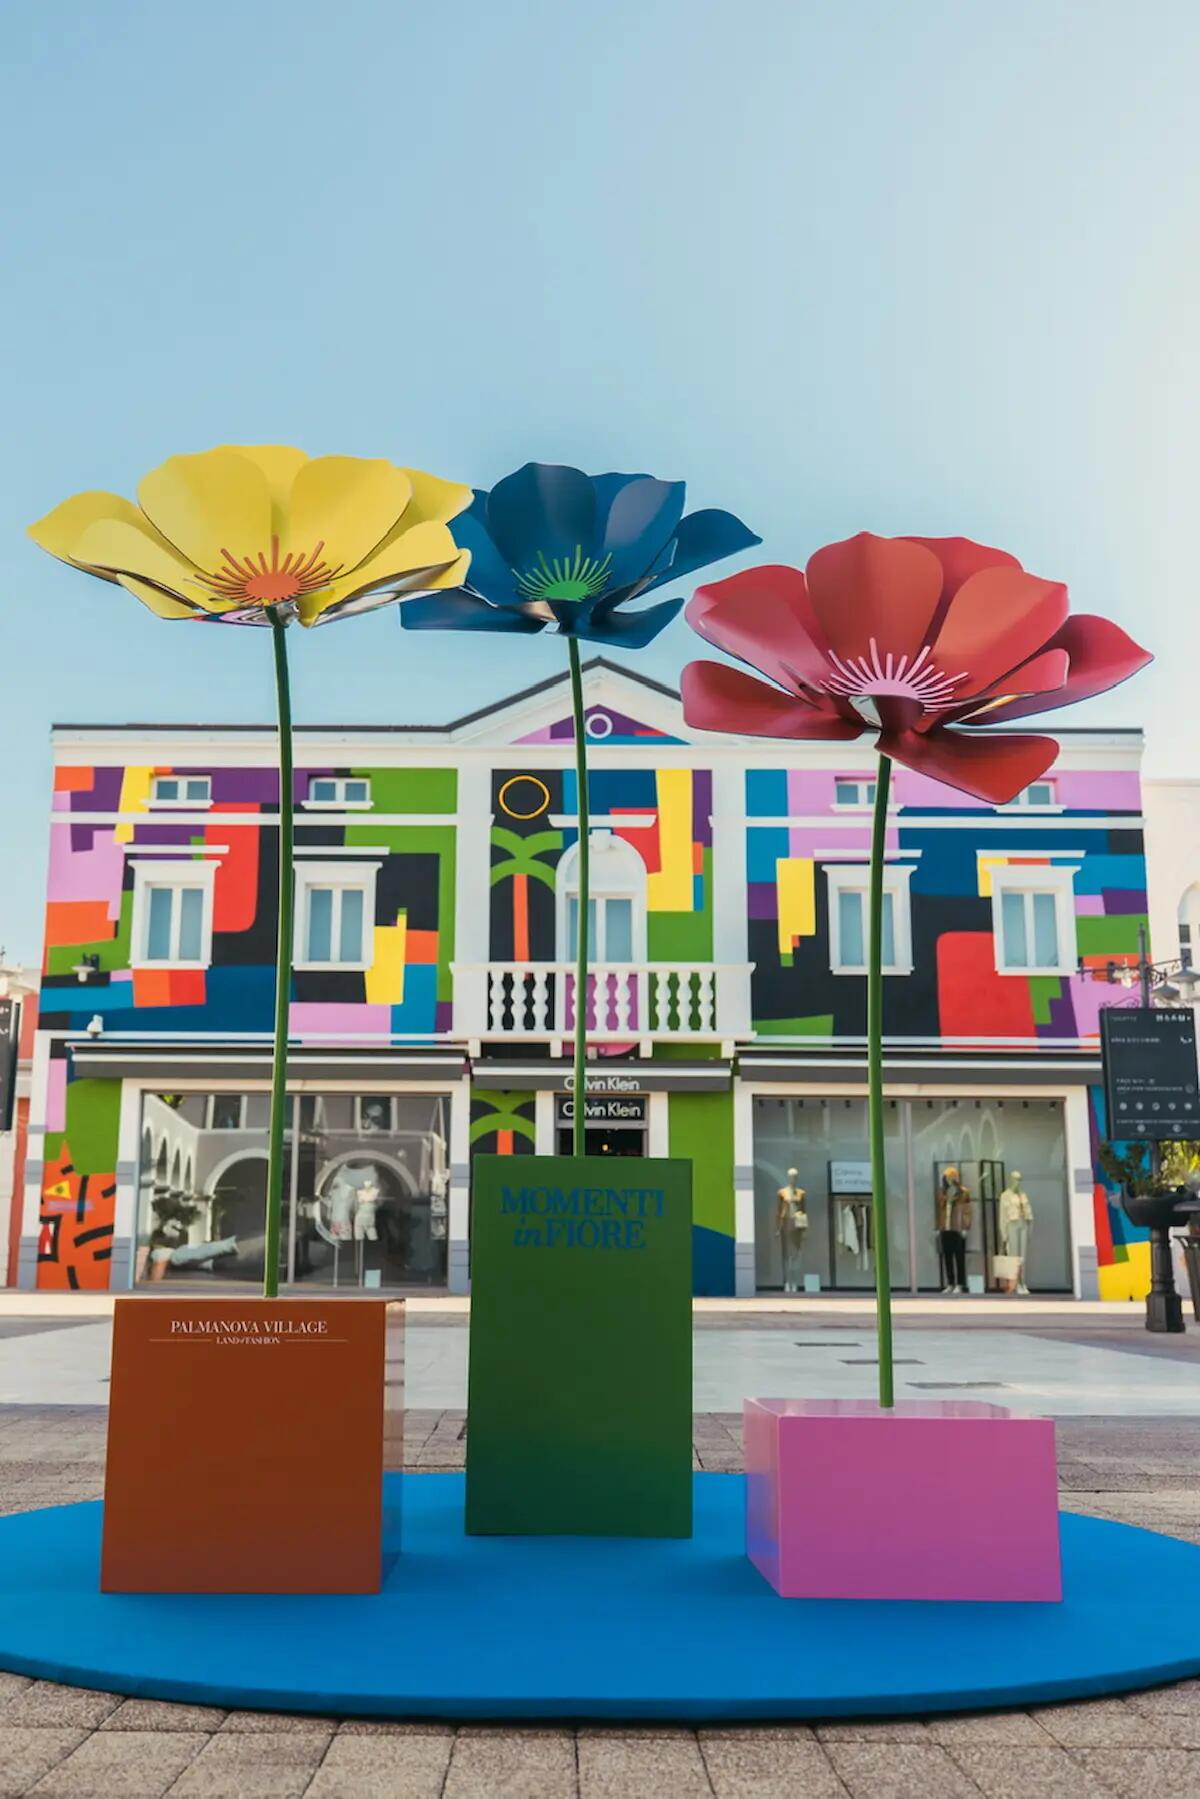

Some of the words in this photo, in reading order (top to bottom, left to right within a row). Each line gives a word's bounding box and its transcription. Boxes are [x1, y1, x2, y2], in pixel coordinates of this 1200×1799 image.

[563, 1076, 606, 1091] Clvin
[607, 1077, 640, 1091] Klein
[562, 1101, 606, 1117] Clvin
[607, 1102, 641, 1117] Klein
[501, 1185, 664, 1217] MOMENTI
[513, 1216, 542, 1247] in
[544, 1218, 646, 1249] FIORE
[170, 1320, 259, 1334] PALMANOVA
[263, 1320, 328, 1334] VILLAGE
